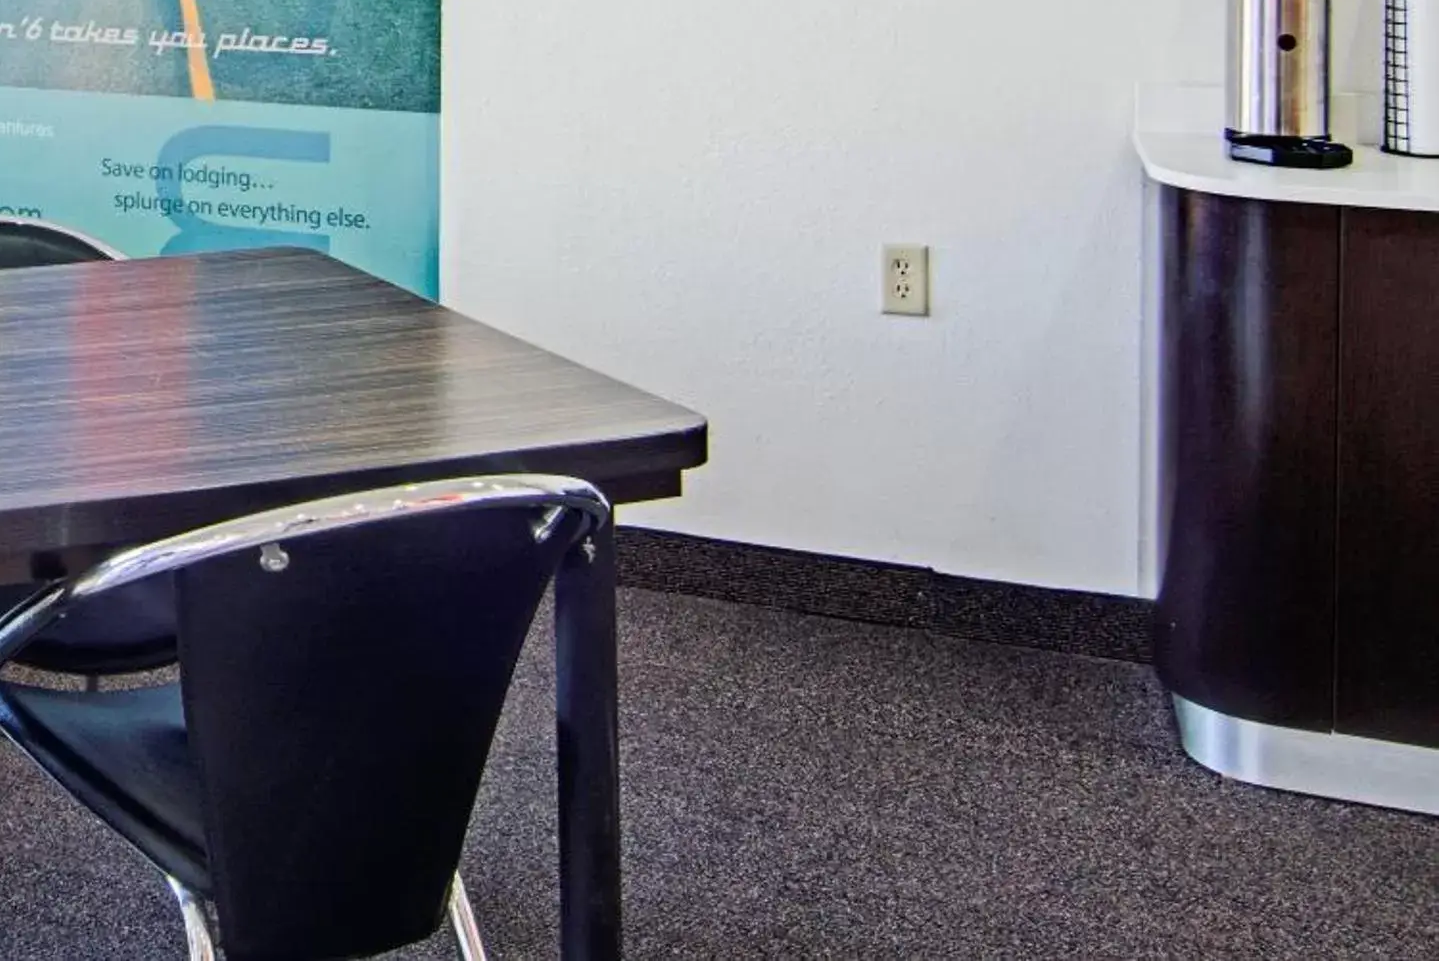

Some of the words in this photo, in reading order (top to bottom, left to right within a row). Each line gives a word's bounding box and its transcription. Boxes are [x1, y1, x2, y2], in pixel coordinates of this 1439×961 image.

[49, 20, 140, 45] takes
[148, 28, 209, 56] you
[211, 27, 338, 60] places.
[101, 158, 144, 178] Save
[148, 164, 173, 181] on
[114, 191, 184, 217] splurge
[187, 198, 213, 215] on
[217, 201, 321, 230] everything
[326, 207, 372, 230] else.
